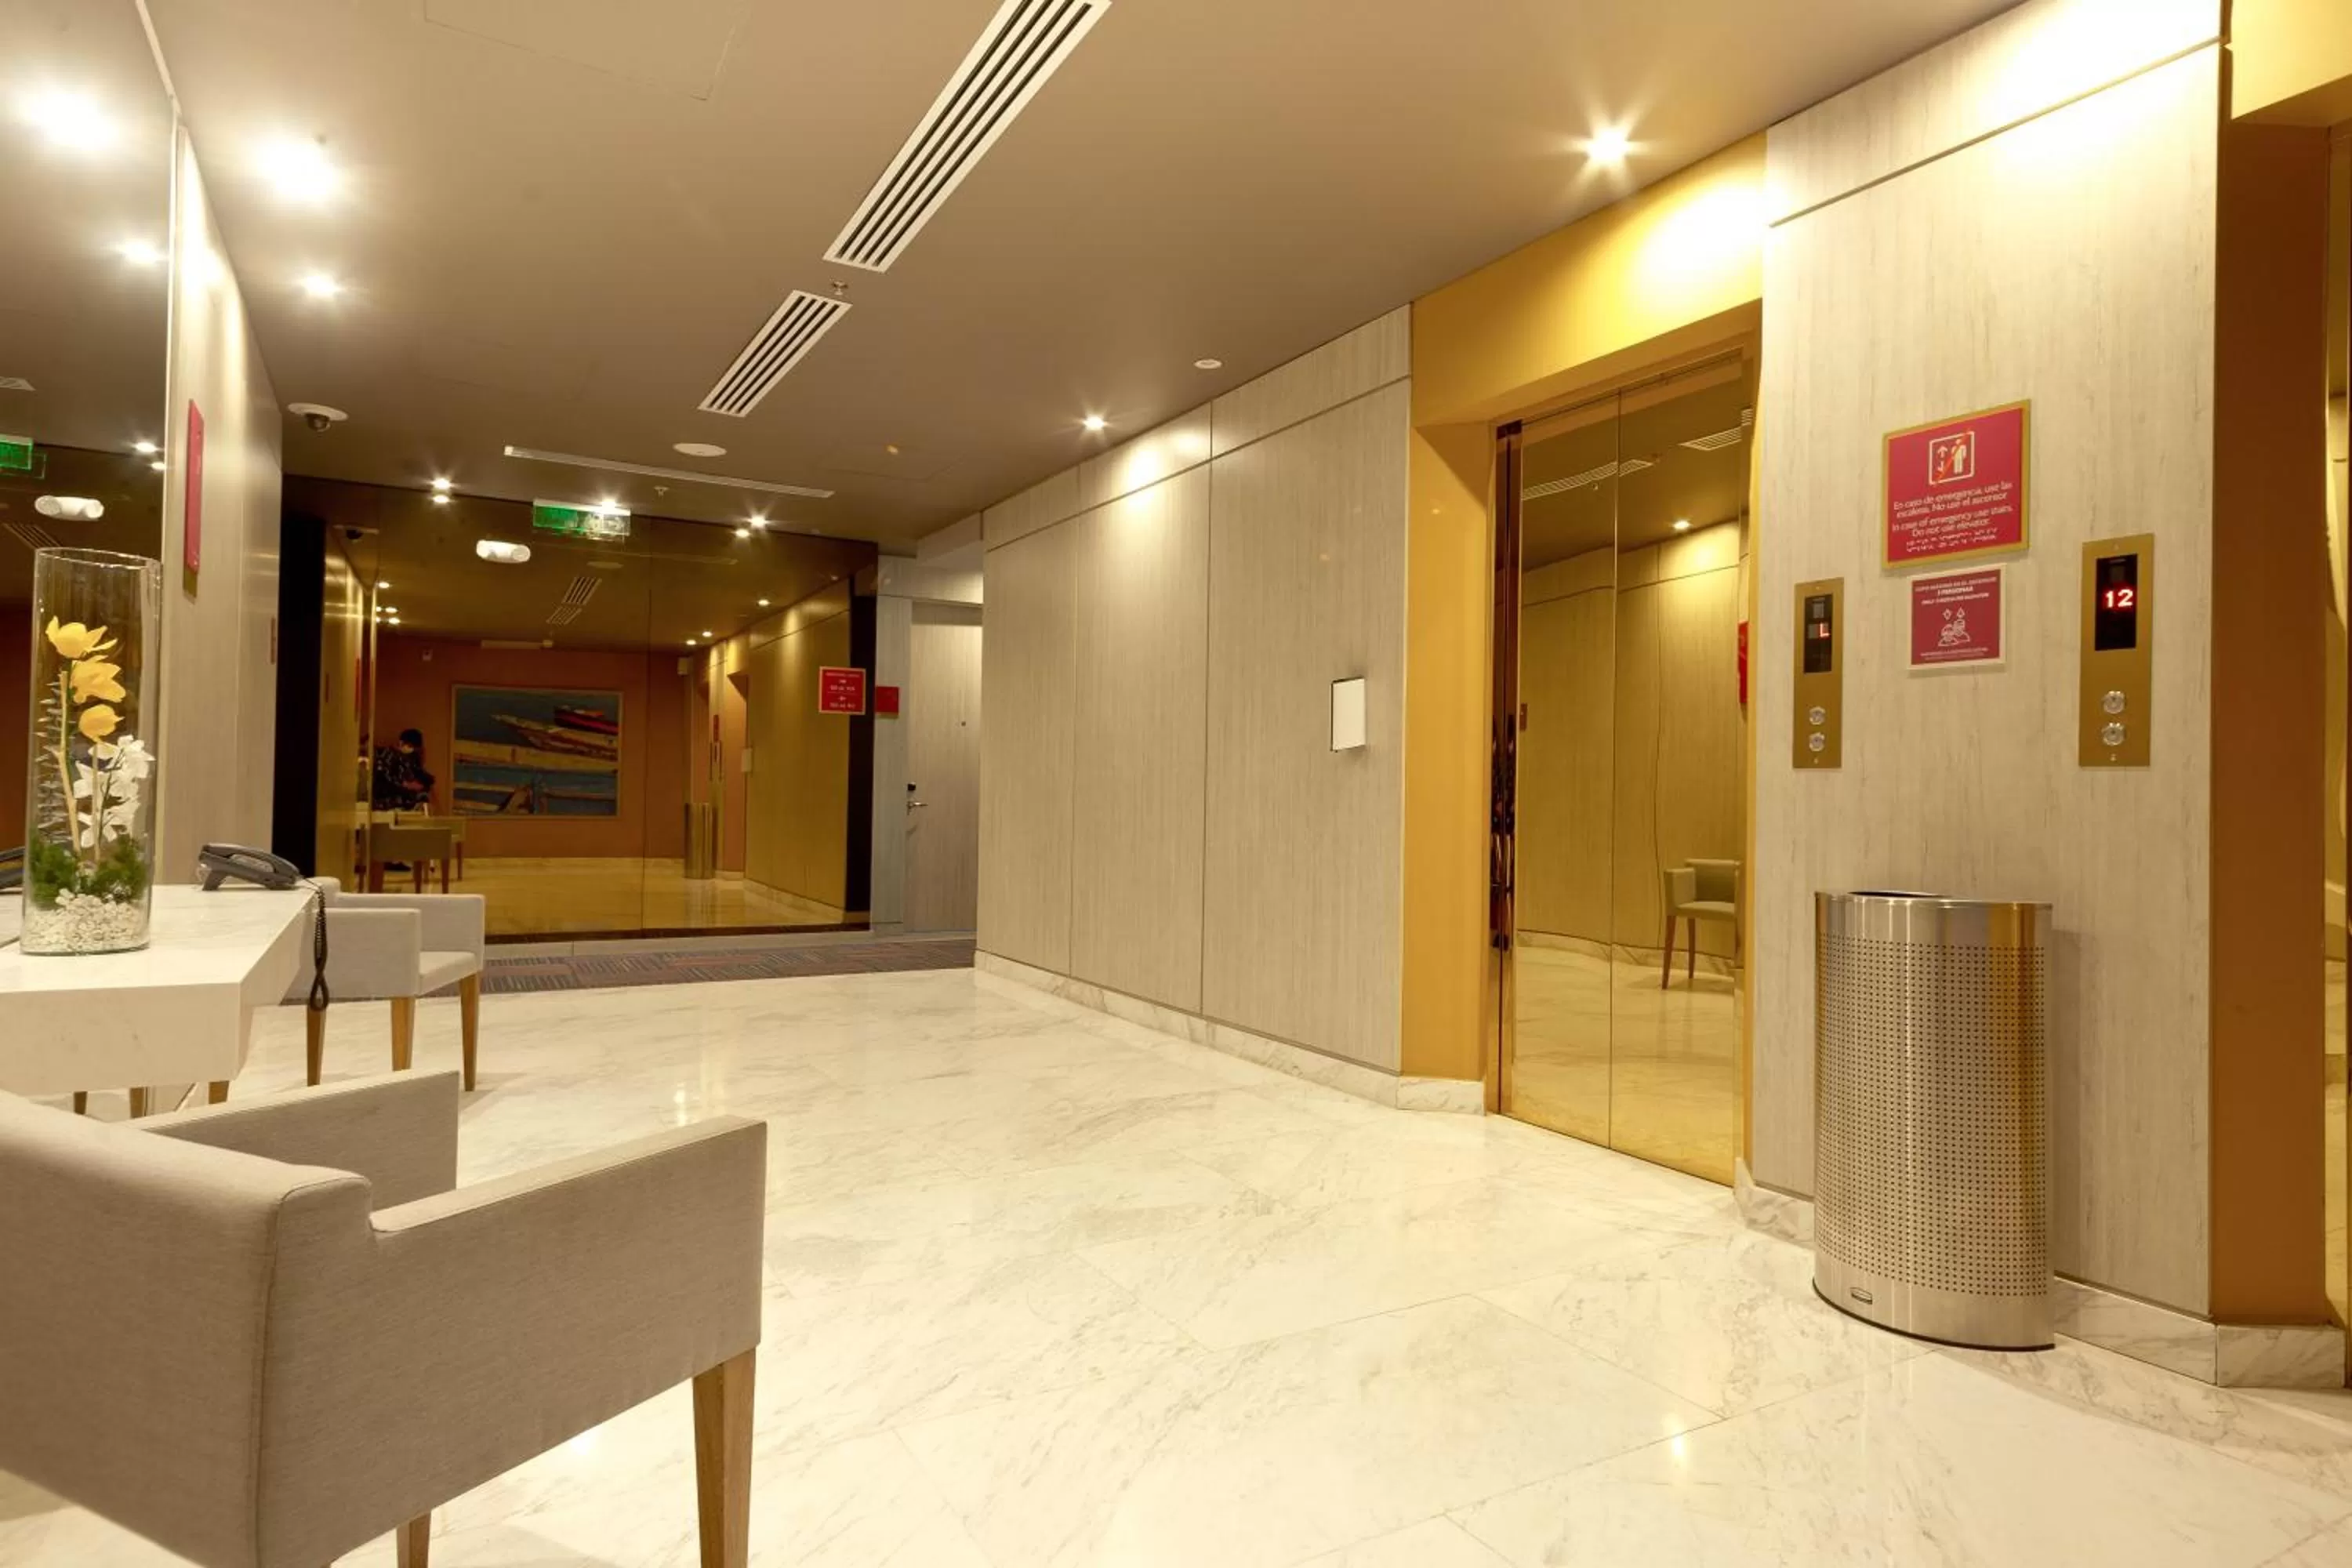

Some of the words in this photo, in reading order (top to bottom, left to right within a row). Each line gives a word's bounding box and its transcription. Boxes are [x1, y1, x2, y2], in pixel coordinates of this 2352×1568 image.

[1893, 501, 1904, 510] En
[1904, 499, 1922, 508] caso
[1923, 495, 1934, 505] de
[1984, 484, 1999, 493] use
[1931, 503, 1945, 512] No
[1947, 500, 1962, 510] use
[1962, 496, 1970, 506] el
[1892, 523, 1900, 532] In
[1900, 521, 1918, 531] case
[1918, 517, 1929, 528] of
[1973, 510, 1990, 519] use
[1911, 528, 1925, 538] Do
[1925, 525, 1940, 535] not
[2105, 589, 2133, 608] 12
[1820, 622, 1830, 637] L
